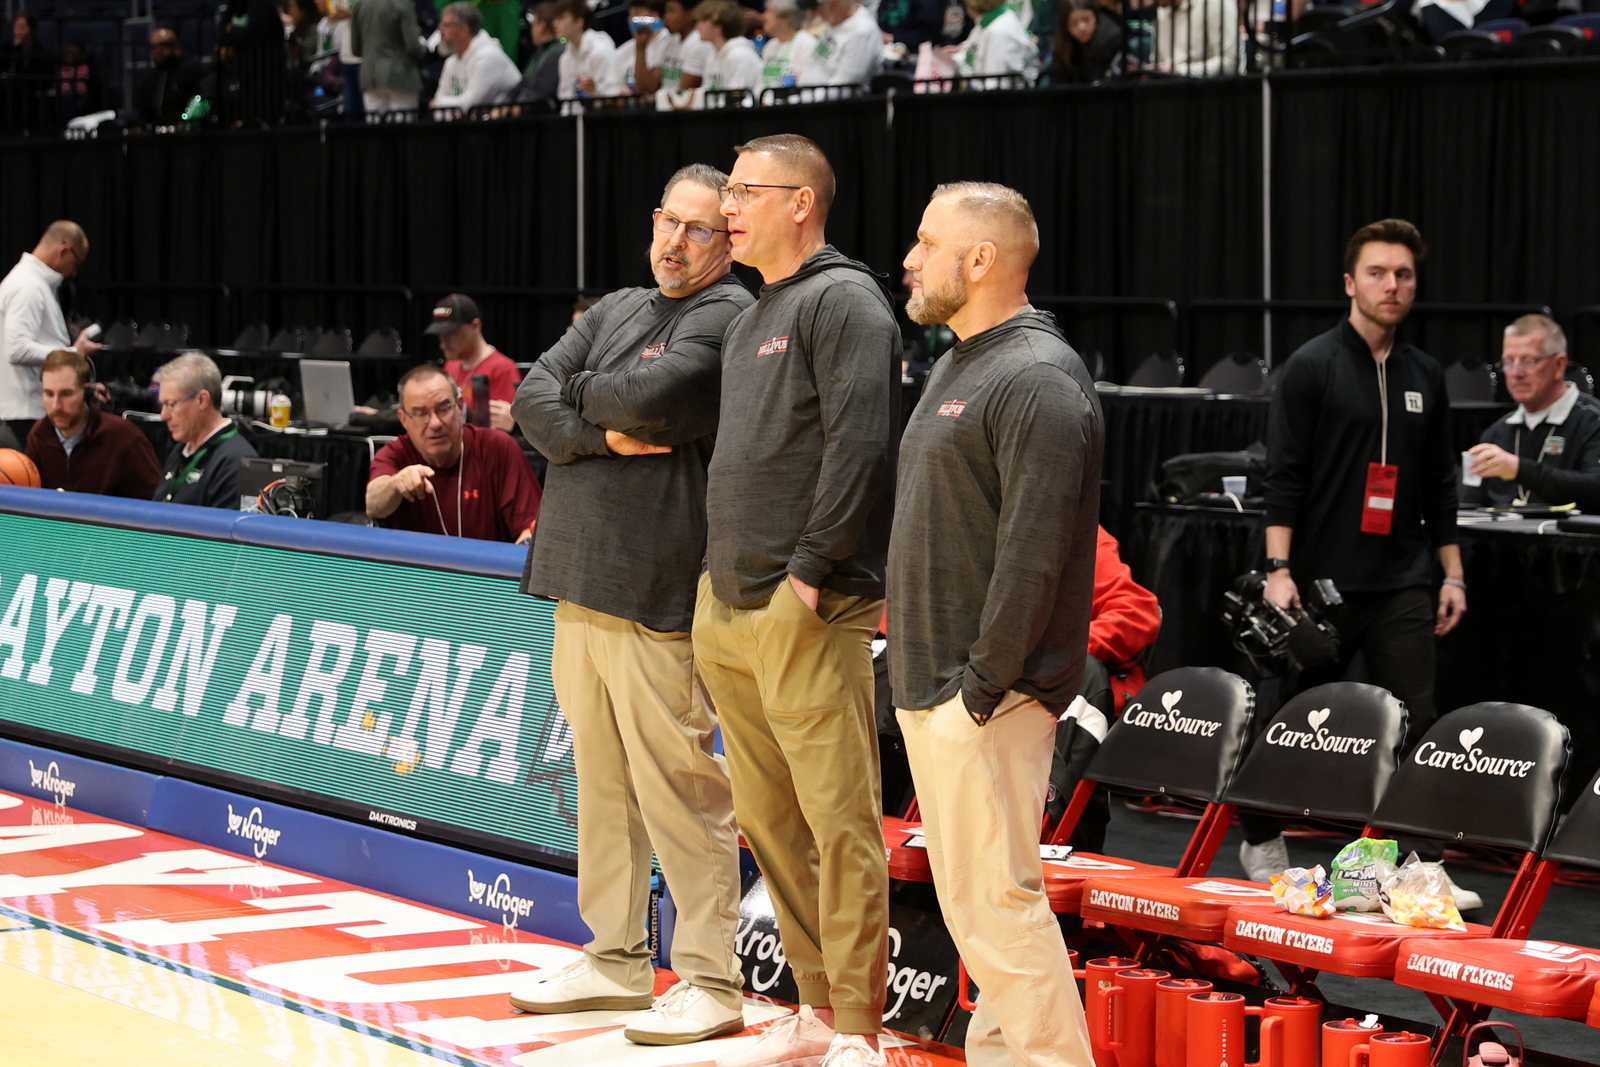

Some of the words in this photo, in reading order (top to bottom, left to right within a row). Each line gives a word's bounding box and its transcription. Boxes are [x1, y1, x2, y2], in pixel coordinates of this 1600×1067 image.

[0, 573, 238, 717] AYTON
[222, 613, 531, 784] ARENA
[1123, 702, 1221, 737] CareSource
[1265, 722, 1375, 755] CareSource
[1414, 741, 1534, 778] CareSource
[43, 761, 76, 806] Kroger
[241, 806, 281, 858] Kroger
[368, 810, 417, 831] DAKTRONICS
[486, 873, 534, 928] Kroger
[1089, 889, 1135, 912] DAYTON
[1136, 897, 1180, 921] FLYERS
[651, 893, 659, 960] POWERADE
[1235, 919, 1286, 945] DAYTON
[1285, 930, 1334, 954] FLYERS
[735, 917, 792, 993] Krog
[882, 927, 948, 1023] oger
[1406, 953, 1463, 980] DAYTON
[1461, 965, 1515, 991] FLYERS
